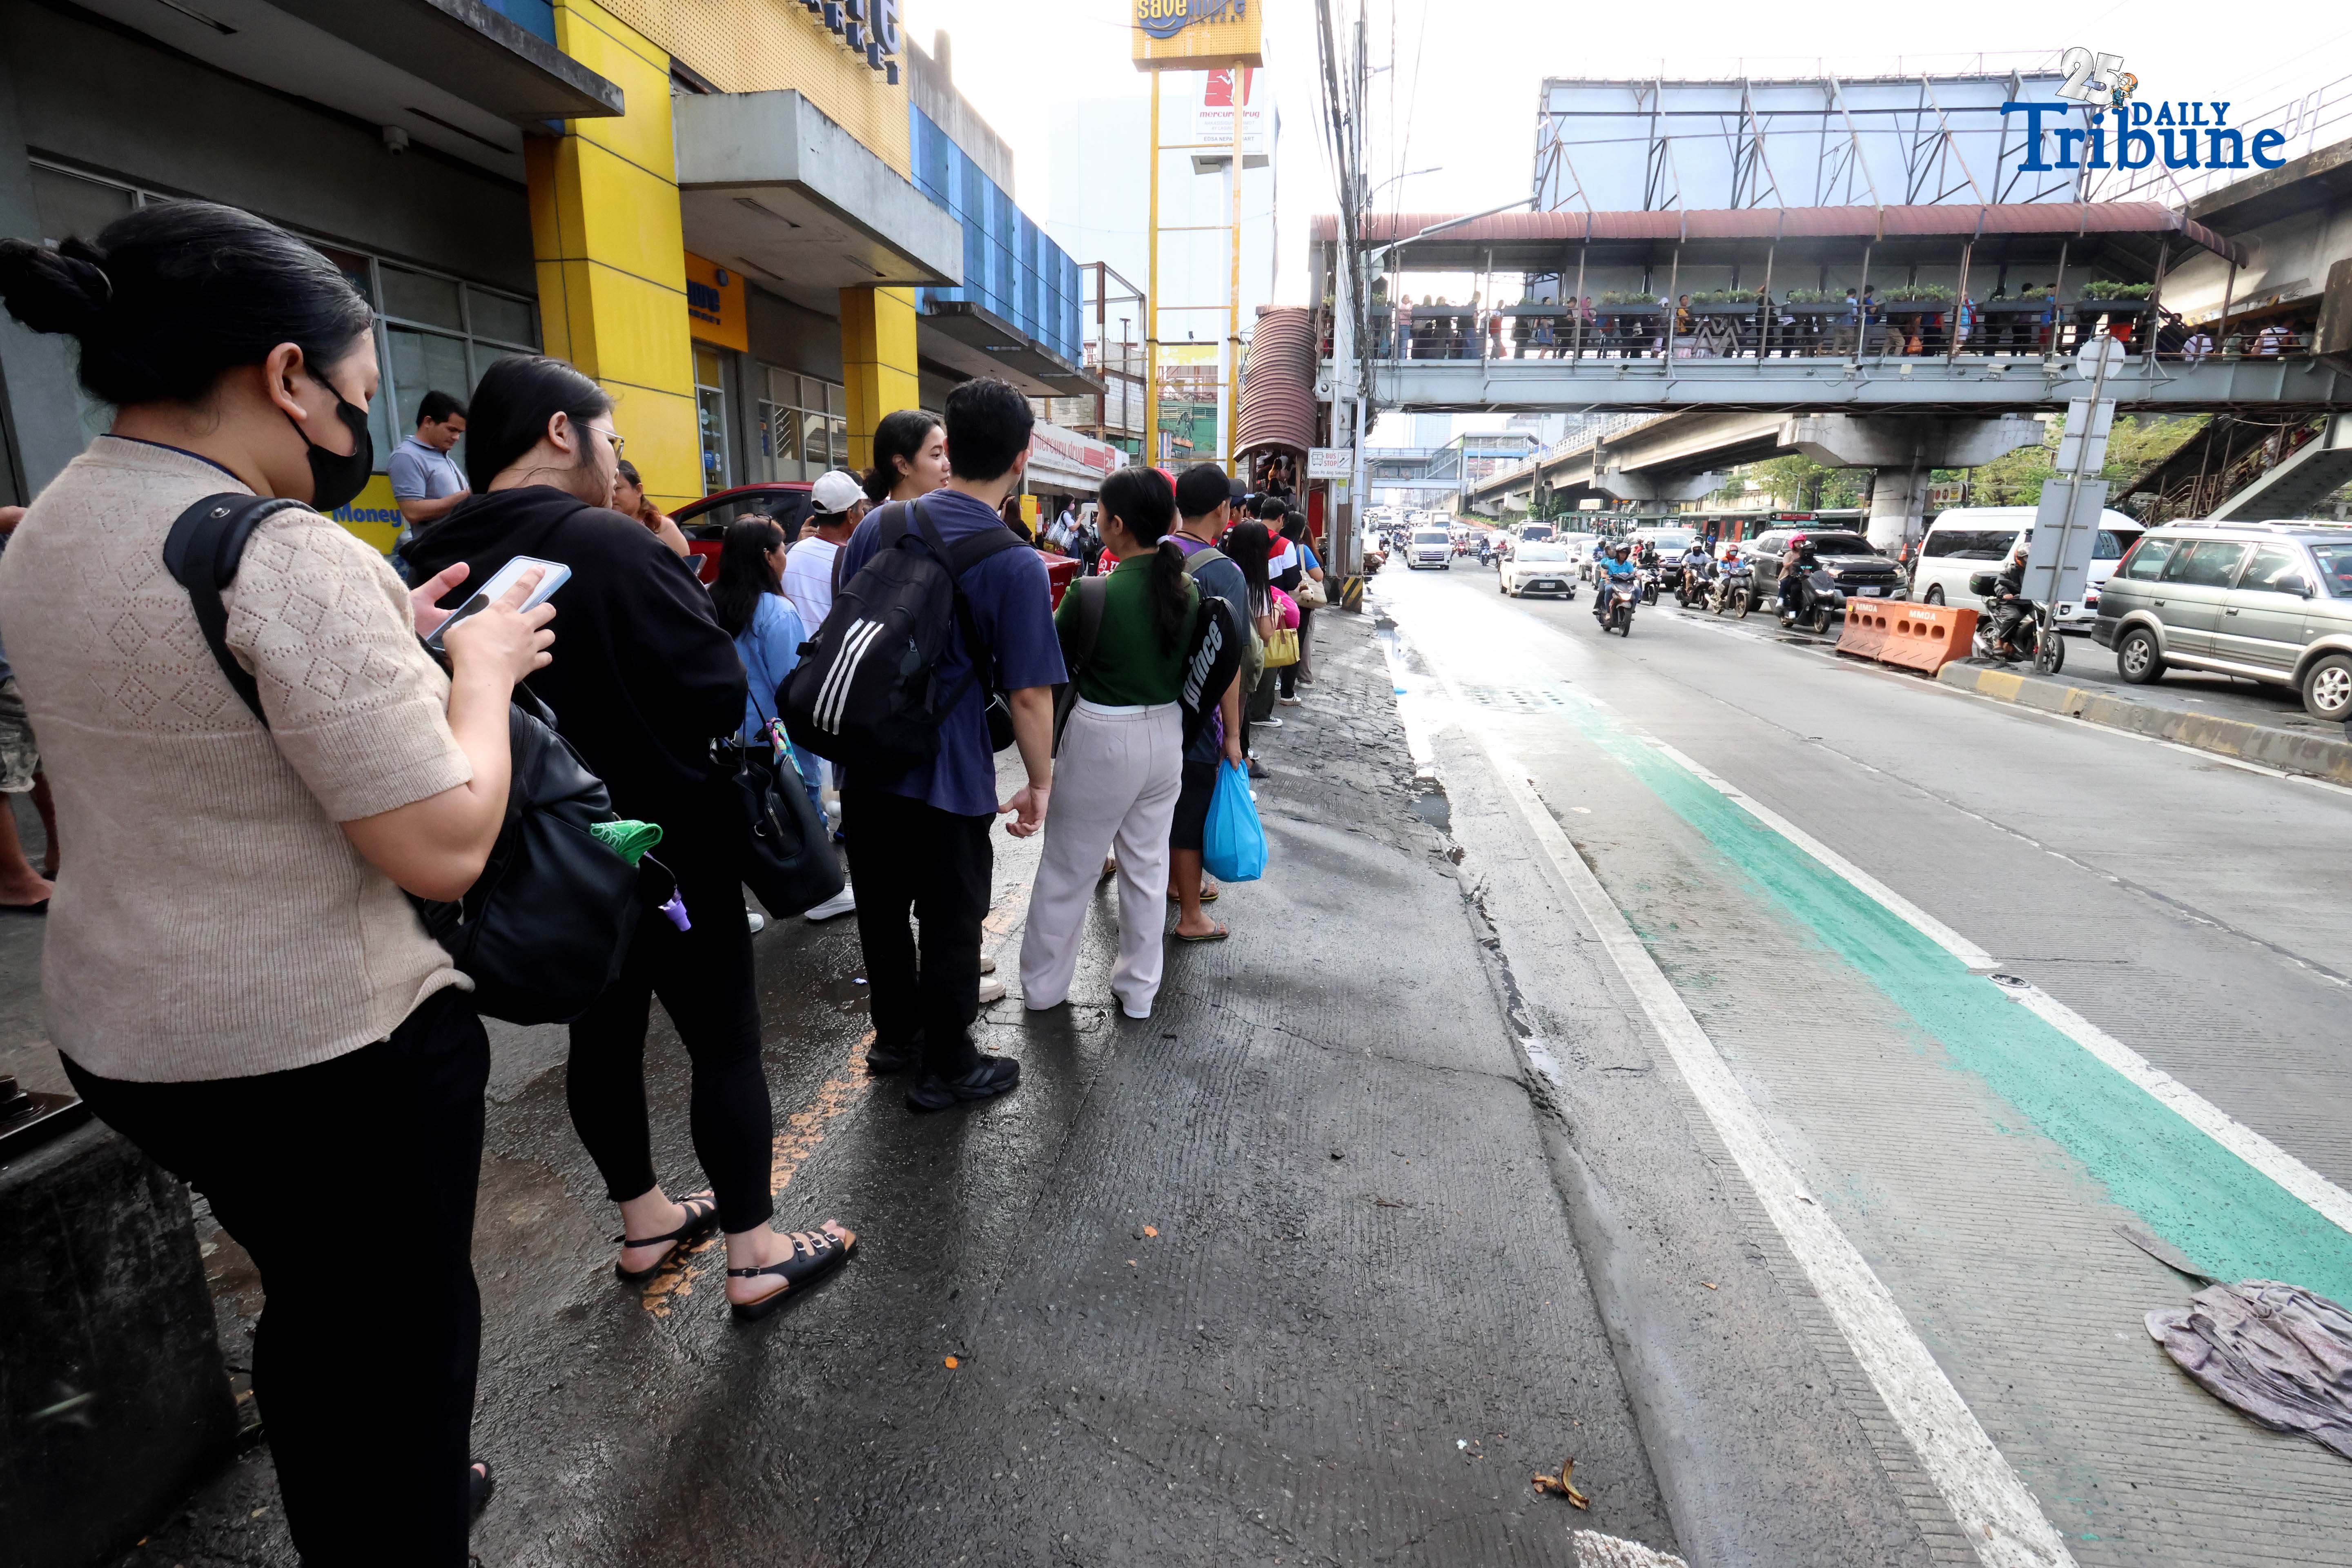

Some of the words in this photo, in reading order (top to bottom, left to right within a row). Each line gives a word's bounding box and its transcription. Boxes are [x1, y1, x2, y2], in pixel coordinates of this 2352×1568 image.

[1105, 457, 1114, 469] 24
[333, 503, 402, 528] Money
[1856, 604, 1878, 612] MMDA
[1909, 610, 1936, 621] MMDA
[1183, 621, 1222, 714] prince
